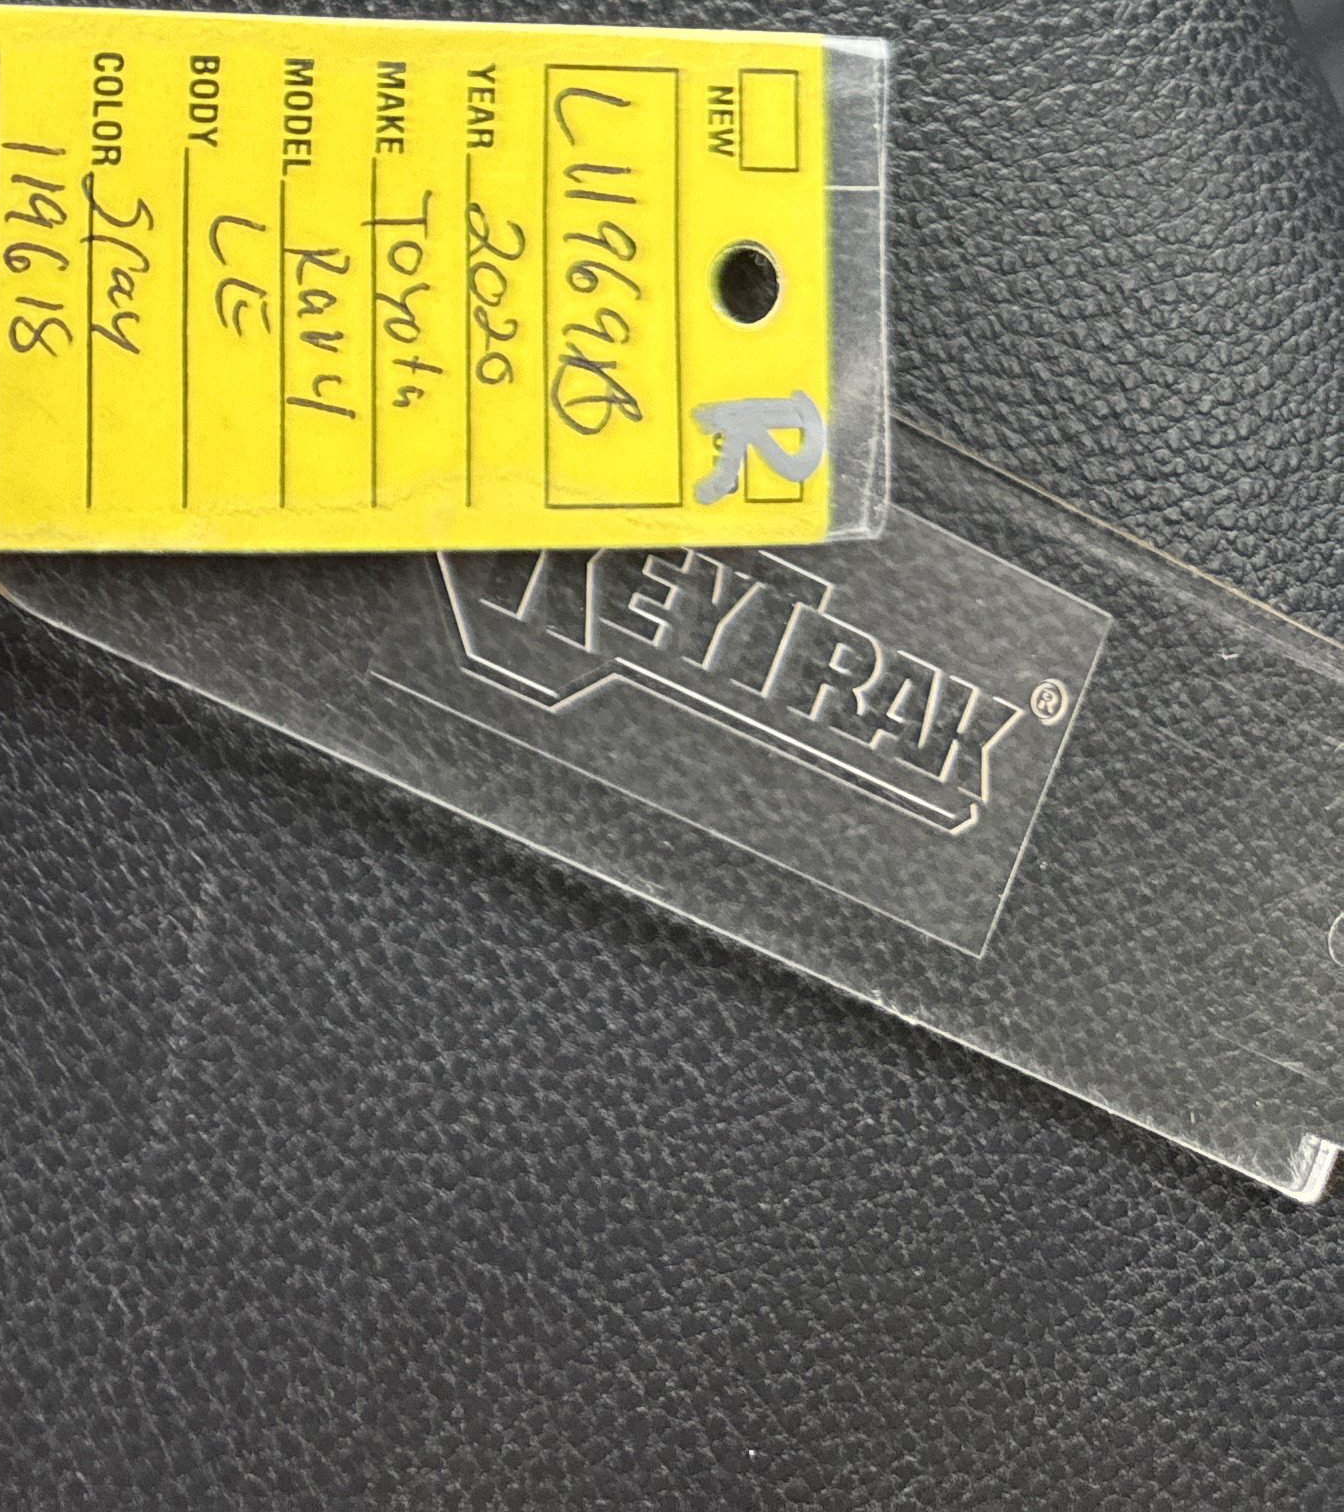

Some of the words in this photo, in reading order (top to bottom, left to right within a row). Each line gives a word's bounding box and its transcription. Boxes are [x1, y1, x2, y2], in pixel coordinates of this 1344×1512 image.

[91, 51, 123, 168] COLOR
[189, 54, 220, 149] BODY
[282, 58, 313, 176] MODEL
[376, 60, 405, 156] MAKE
[468, 62, 495, 150] YEAR
[707, 84, 735, 159] NEW
[0, 139, 74, 358] 119618
[208, 214, 272, 338] LE
[361, 189, 445, 408] Toyota
[465, 201, 527, 386] 2020
[692, 390, 826, 505] R
